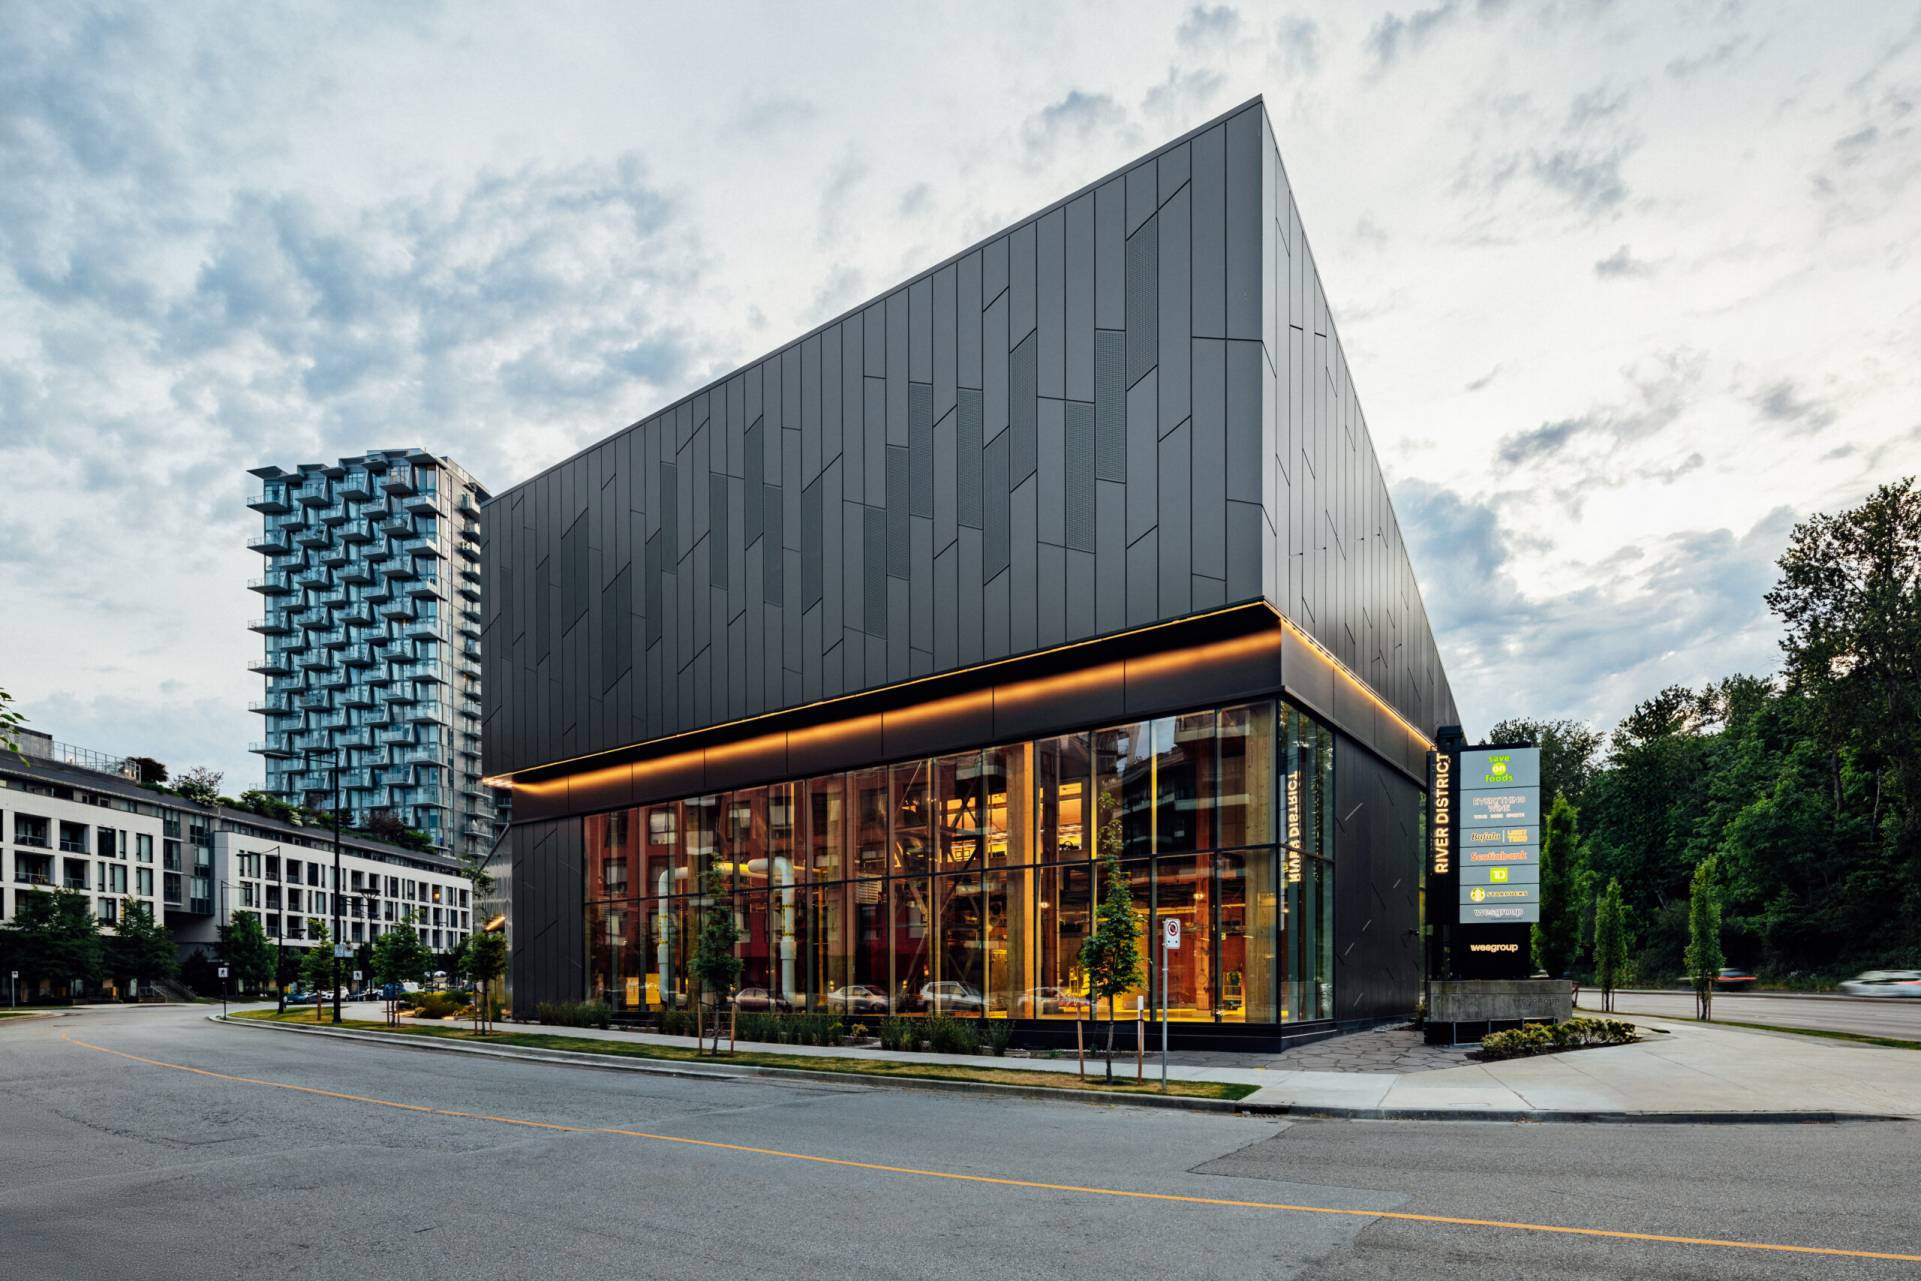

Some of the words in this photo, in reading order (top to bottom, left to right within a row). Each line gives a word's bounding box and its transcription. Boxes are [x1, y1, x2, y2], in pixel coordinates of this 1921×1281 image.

[1436, 753, 1449, 824] DISTRICT
[1485, 773, 1513, 783] foods
[1435, 828, 1449, 873] RIVER
[1494, 870, 1506, 880] TD
